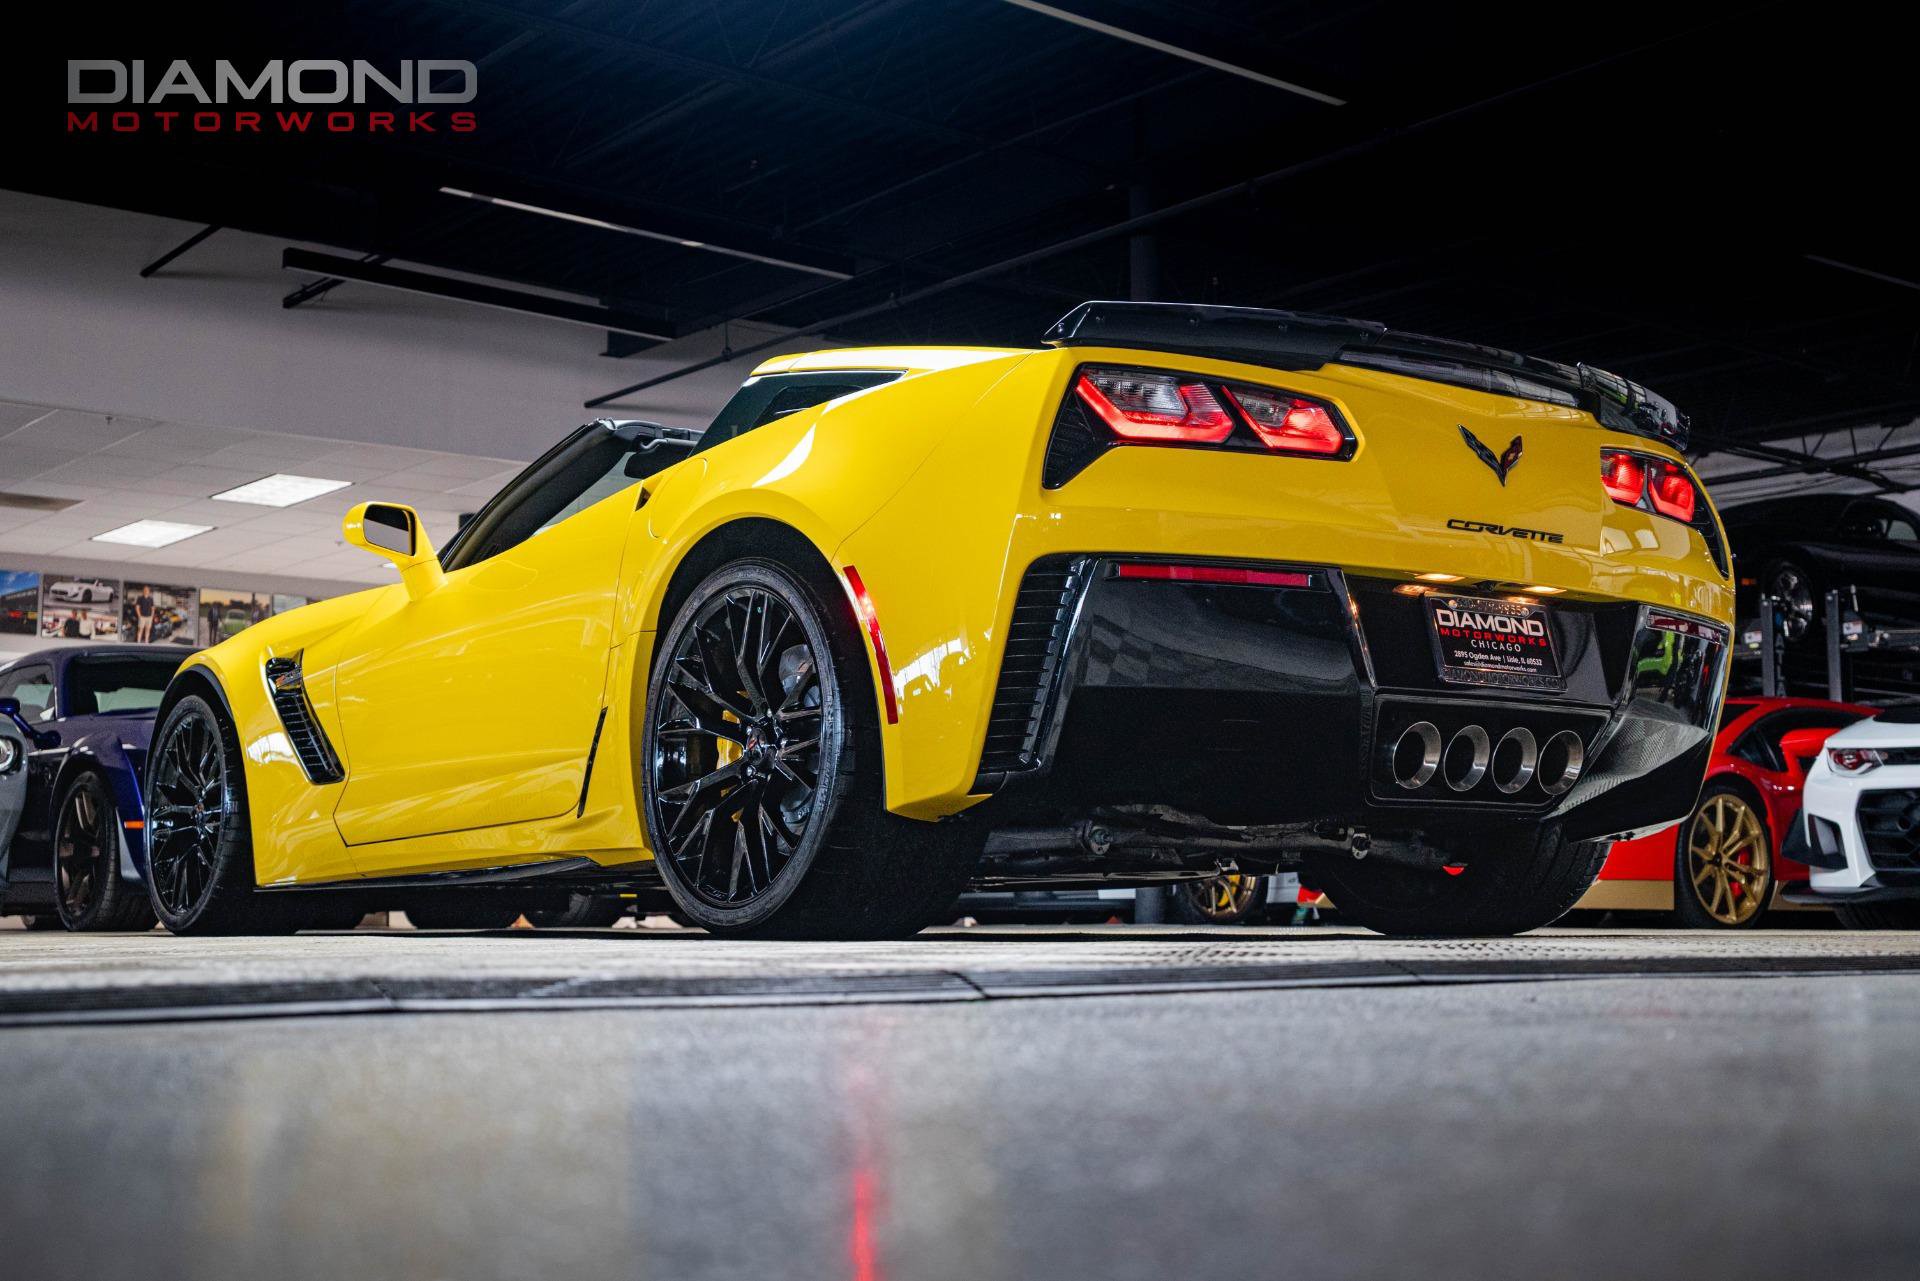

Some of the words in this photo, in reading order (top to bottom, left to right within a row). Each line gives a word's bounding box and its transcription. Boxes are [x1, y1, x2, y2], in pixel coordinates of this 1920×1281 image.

[1446, 518, 1564, 544] CORVETTE
[1436, 608, 1545, 637] DIAMOND
[1440, 627, 1547, 647] MOTORWORKS
[1471, 639, 1521, 652] CHICAGO
[1468, 651, 1490, 661] Ogden
[1490, 653, 1502, 662] Ave
